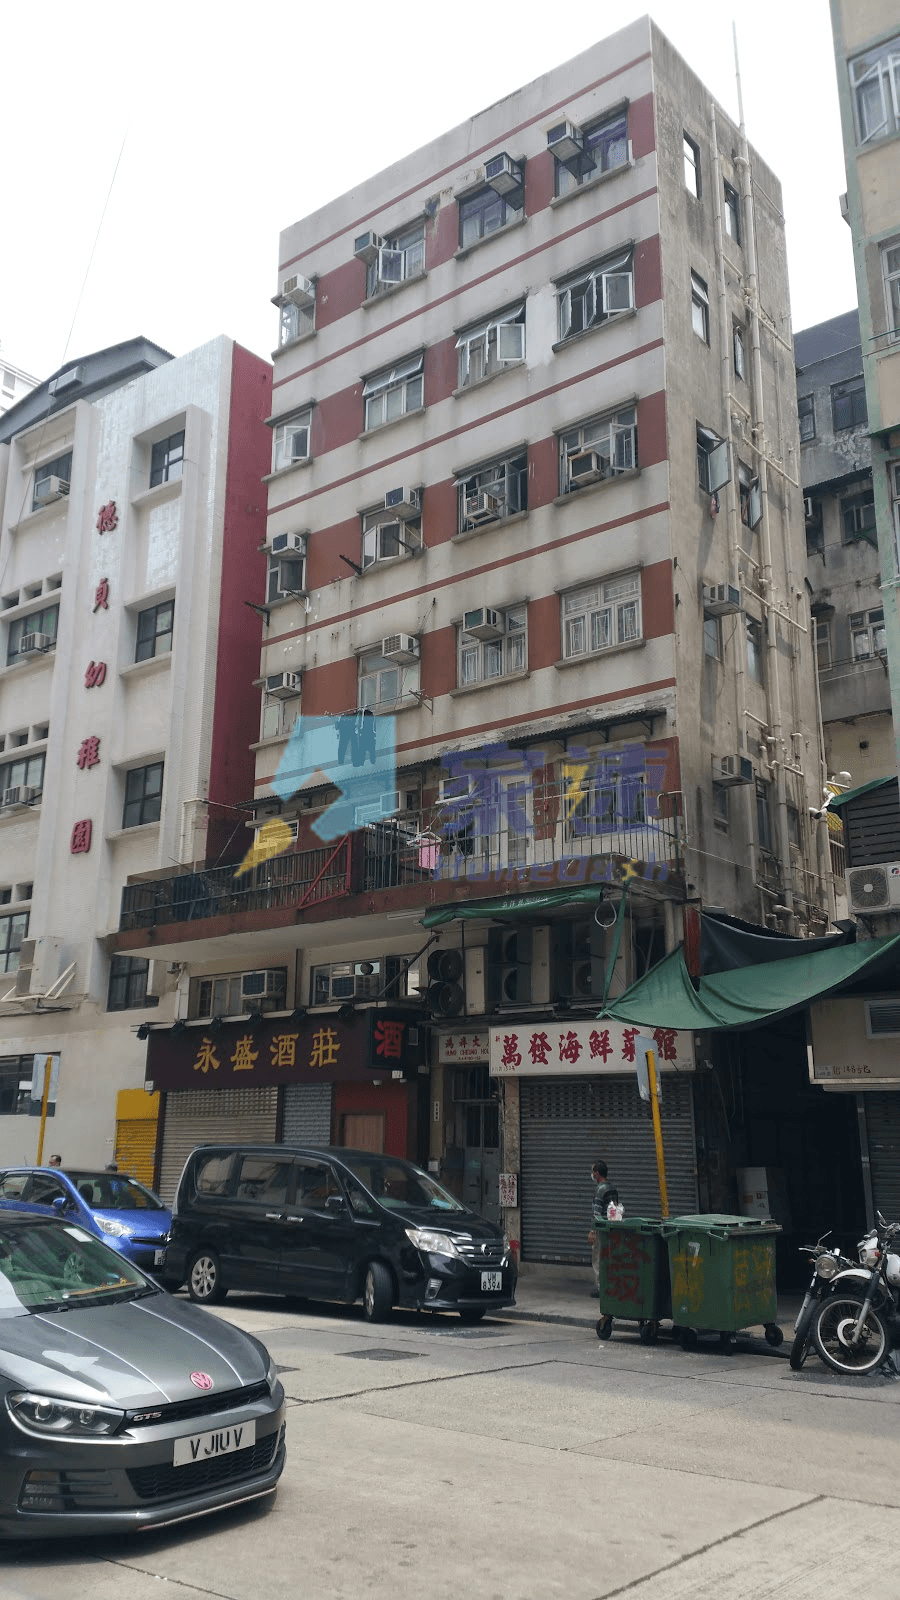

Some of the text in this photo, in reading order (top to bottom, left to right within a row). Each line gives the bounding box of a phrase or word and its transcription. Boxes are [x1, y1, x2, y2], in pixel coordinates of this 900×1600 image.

[193, 1027, 341, 1073] 永盛酒莊
[374, 1020, 405, 1059] 酒
[133, 1411, 162, 1422] GTS
